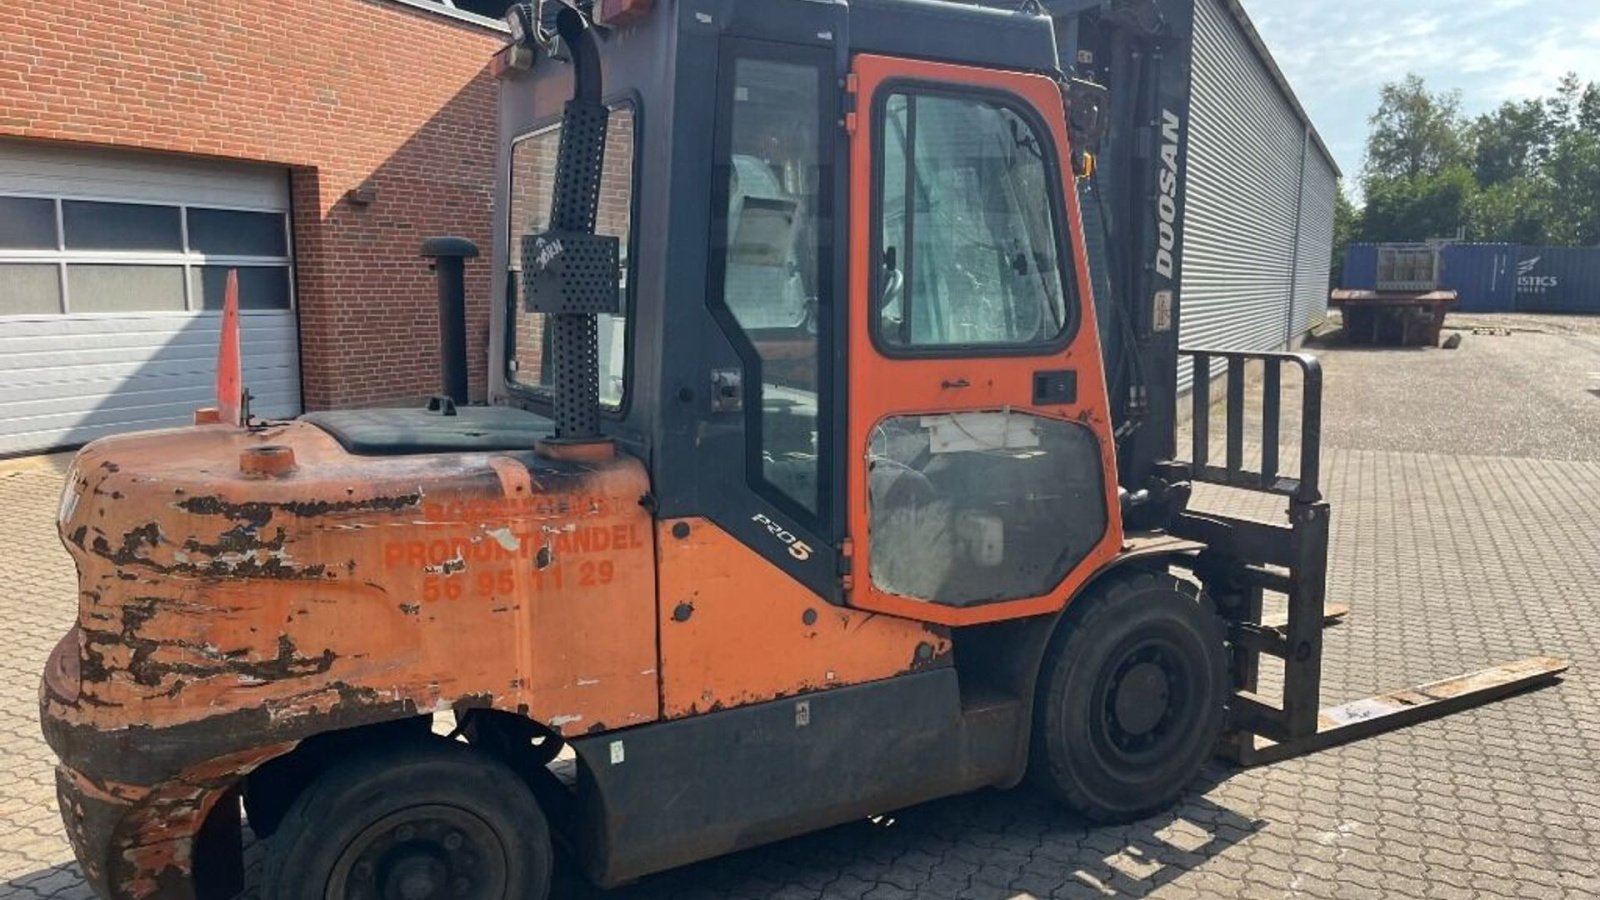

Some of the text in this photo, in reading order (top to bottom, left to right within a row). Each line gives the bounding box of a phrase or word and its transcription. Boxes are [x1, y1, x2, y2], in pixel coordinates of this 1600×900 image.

[1156, 108, 1179, 280] DOOSAN
[423, 576, 461, 603] 56
[478, 569, 514, 597] 95
[578, 560, 614, 587] 29
